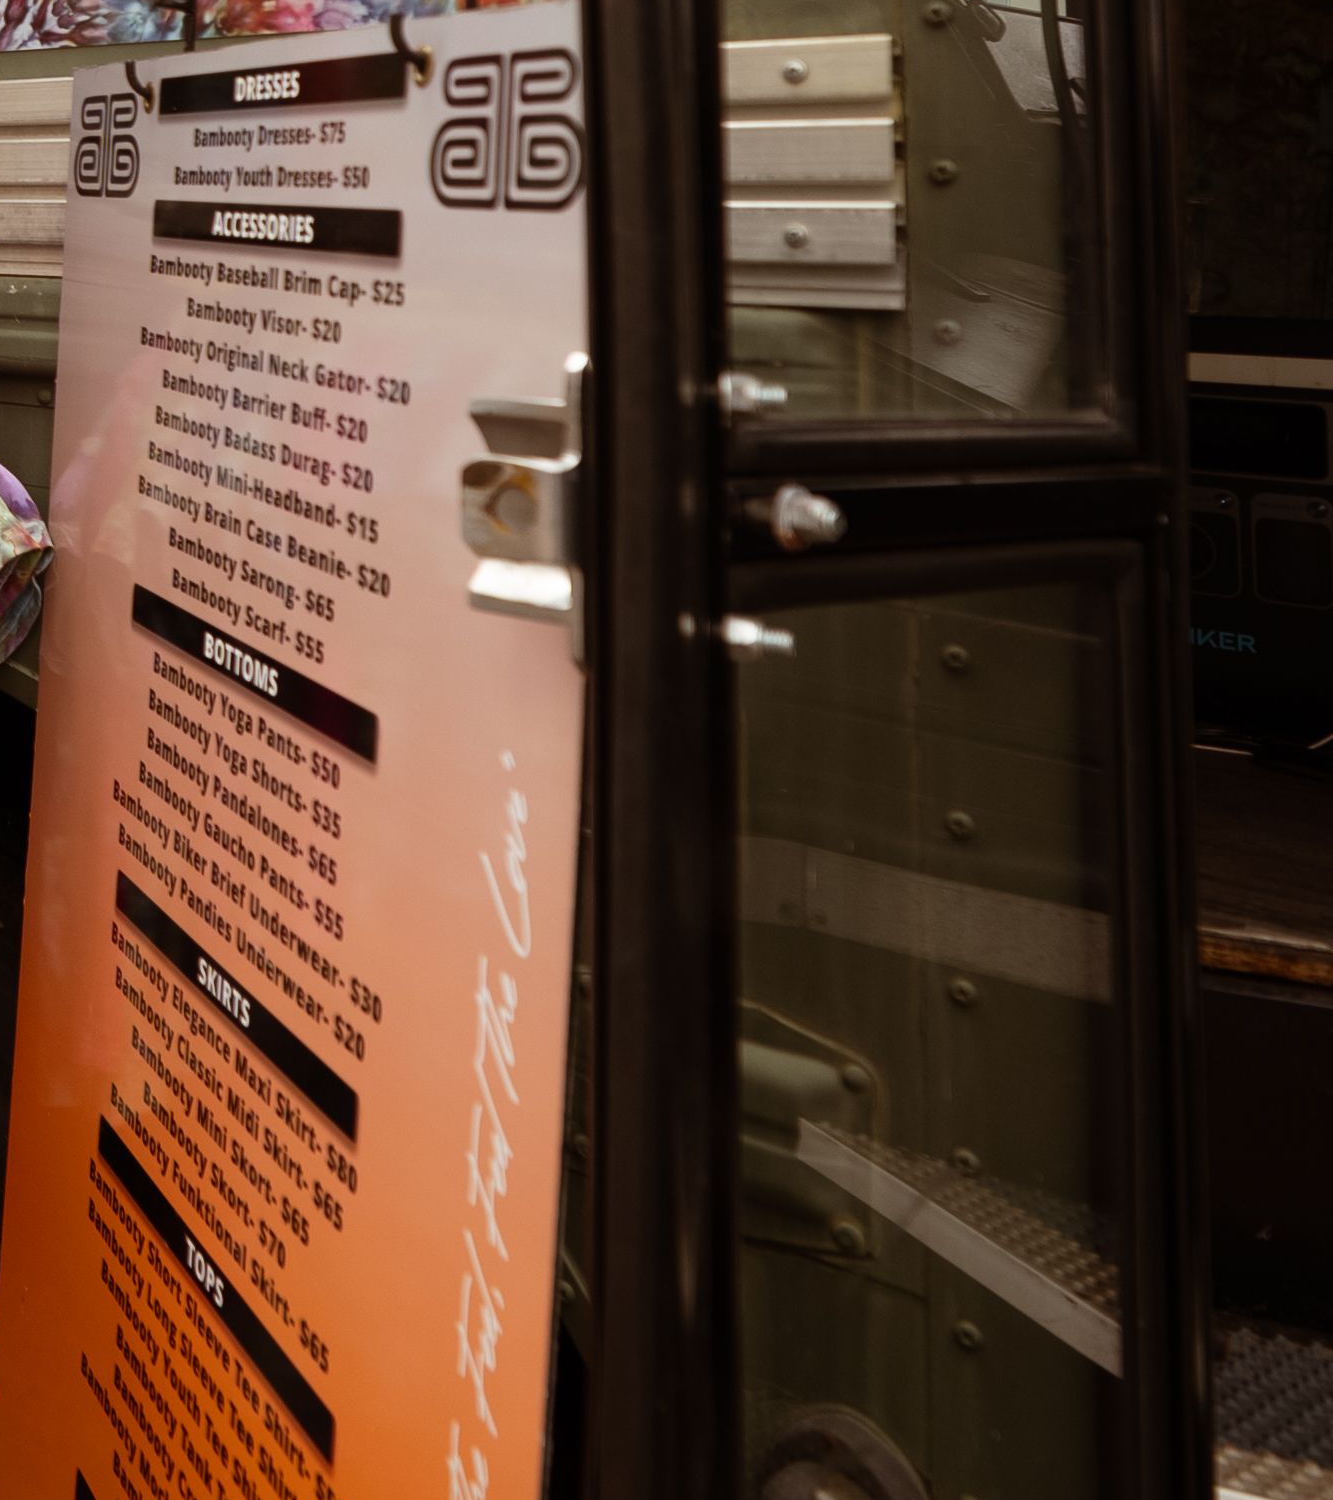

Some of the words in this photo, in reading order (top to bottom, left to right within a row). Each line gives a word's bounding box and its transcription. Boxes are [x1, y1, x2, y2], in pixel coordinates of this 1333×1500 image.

[193, 127, 254, 151] Bambooty
[257, 125, 315, 145] Dresses-
[319, 121, 344, 143] $75
[234, 70, 299, 101] DRESSES
[174, 166, 232, 191] Bambooty
[235, 165, 272, 186] Youth
[276, 166, 337, 187] Dresses-
[342, 166, 369, 188] $50
[211, 211, 313, 242] ACCESSORIES
[150, 254, 213, 286] Bambooty
[216, 262, 278, 289] Baseball
[283, 269, 321, 295] Brim
[327, 275, 365, 306] Cap-
[372, 280, 403, 306] $25
[187, 297, 256, 334] Bambooty
[260, 309, 306, 335] Visor-
[312, 318, 340, 343] $20
[140, 326, 202, 363] Bambooty
[206, 340, 263, 371] Original
[268, 353, 308, 382] Neck
[314, 363, 370, 393] Gator-
[377, 376, 410, 405] $20
[162, 369, 228, 410] Bambooty
[232, 387, 286, 420] Barrier
[291, 402, 330, 430] Buff-
[336, 414, 367, 442] $20
[148, 440, 212, 487] Bambooty
[216, 465, 341, 527] Mini-Headband-
[346, 511, 378, 543] $15
[155, 405, 220, 448] Bambooty
[224, 426, 275, 461] Badass
[280, 443, 335, 485] Durag-
[341, 462, 372, 492] $20
[138, 474, 200, 522] Bambooty
[204, 501, 241, 535] Brain
[246, 519, 281, 552] Case
[286, 534, 351, 579] Beanie-
[357, 563, 390, 597] $20
[168, 526, 236, 580] Bambooty
[240, 559, 299, 609] Sarong-
[304, 589, 334, 621] $65
[172, 567, 241, 625] Bambooty
[244, 605, 290, 643] Scarf-
[294, 630, 323, 663] $55
[204, 632, 277, 696] BOTTOMS
[148, 688, 211, 754] Bambooty
[215, 732, 247, 775] Yoga
[251, 758, 307, 812] Shorts-
[311, 799, 340, 838] $35
[153, 651, 216, 715] Bambooty
[220, 692, 252, 735] Yoga
[257, 716, 306, 764] Pants-
[310, 751, 339, 788] $50
[138, 760, 200, 832] Bambooty
[203, 812, 255, 870] Gaucho
[259, 854, 309, 909] Pants-
[313, 898, 342, 940] $55
[147, 727, 209, 796] Bambooty
[308, 844, 336, 885] $65
[113, 779, 169, 849] Bambooty
[173, 829, 207, 875] Biker
[210, 860, 245, 908] Brief
[249, 892, 344, 986] Underwear-
[349, 976, 381, 1023] $30
[118, 822, 176, 897] Bambooty
[179, 877, 231, 942] Pandies
[236, 927, 328, 1023] Underwear-
[333, 1014, 364, 1060] $20
[197, 957, 249, 1026] SKIRTS
[111, 921, 168, 1002] Bambooty
[172, 984, 230, 1063] Elegance
[234, 1048, 271, 1105] Maxi
[326, 1143, 357, 1193] $80
[115, 966, 173, 1050] Bambooty
[177, 1034, 223, 1101] Classic
[226, 1086, 259, 1141] Midi
[312, 1180, 342, 1231] $65
[131, 1025, 193, 1116] Bambooty
[196, 1098, 227, 1152] Mini
[280, 1195, 308, 1245] $65
[143, 1081, 207, 1178] Bambooty
[258, 1219, 285, 1268] $70
[89, 1157, 145, 1255] Bambooty
[147, 1240, 181, 1305] Short
[184, 1292, 229, 1372] Sleeve
[234, 1359, 259, 1414] Tee
[110, 1082, 169, 1176] Bambooty
[171, 1159, 246, 1271] Funktional
[299, 1318, 328, 1373] $65
[186, 1236, 223, 1306] TOPS
[88, 1197, 144, 1298] Bambooty
[146, 1282, 177, 1349] Long
[179, 1331, 224, 1413] Sleeve
[228, 1400, 254, 1456] Tee
[100, 1258, 159, 1365] Bambooty
[162, 1348, 200, 1426] Youth
[204, 1412, 228, 1468] Tee
[113, 1363, 174, 1482] Bambooty
[116, 1323, 177, 1439] Bambooty
[180, 1423, 212, 1493] Tank
